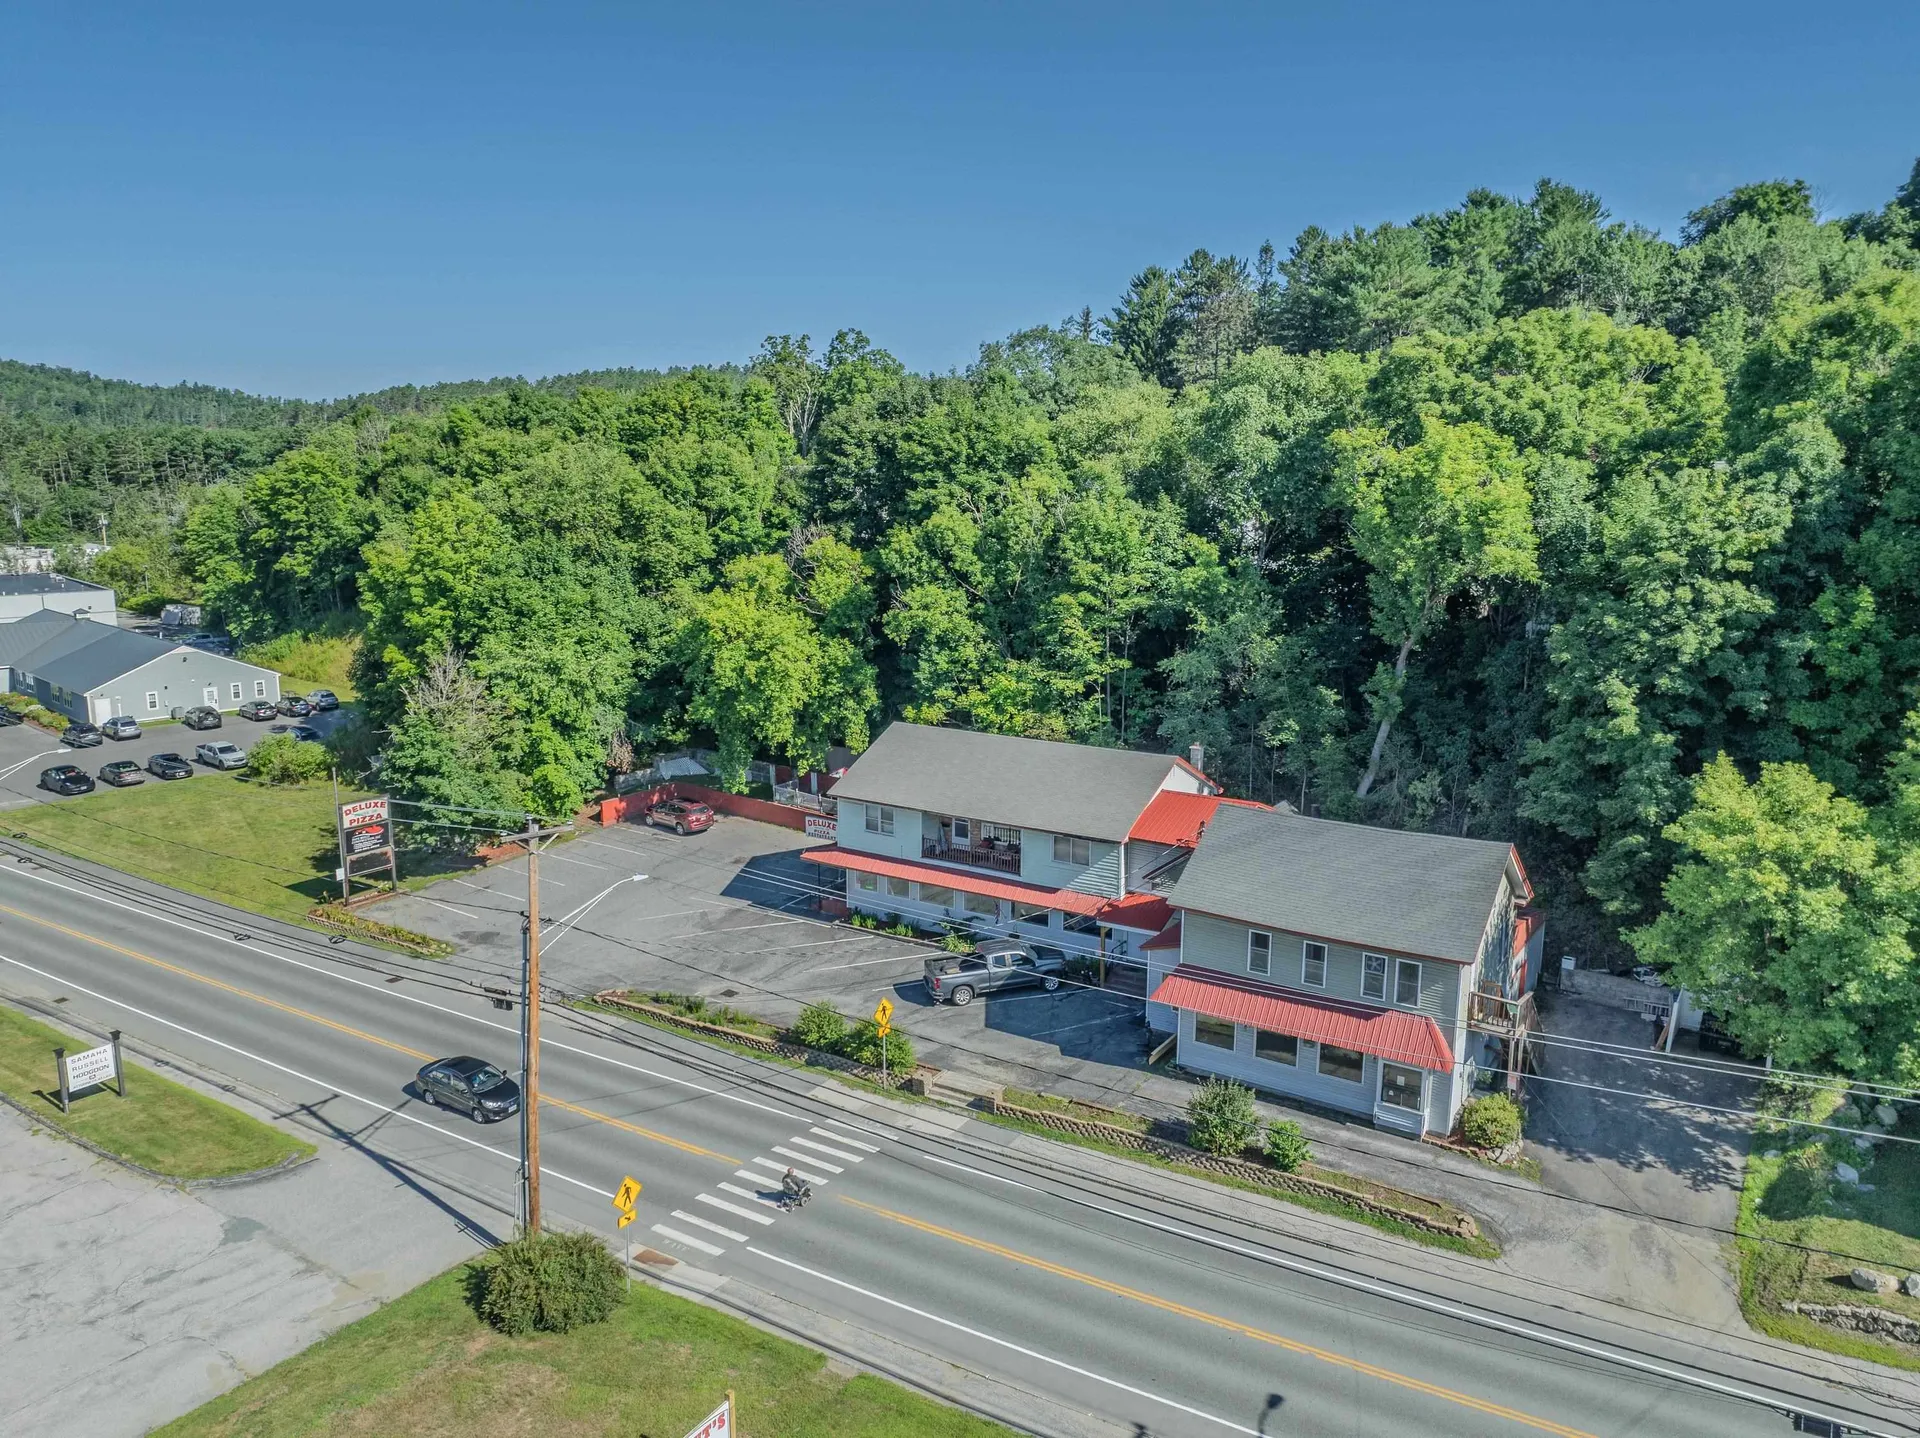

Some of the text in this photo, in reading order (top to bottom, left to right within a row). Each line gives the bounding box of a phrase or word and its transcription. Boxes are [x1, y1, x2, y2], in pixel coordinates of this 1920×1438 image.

[344, 801, 387, 816] DELUXE
[349, 812, 383, 826] PIZZA
[807, 819, 837, 831] DELUXE
[71, 1048, 108, 1064] SAMAHA
[72, 1056, 109, 1072] RUSSELL
